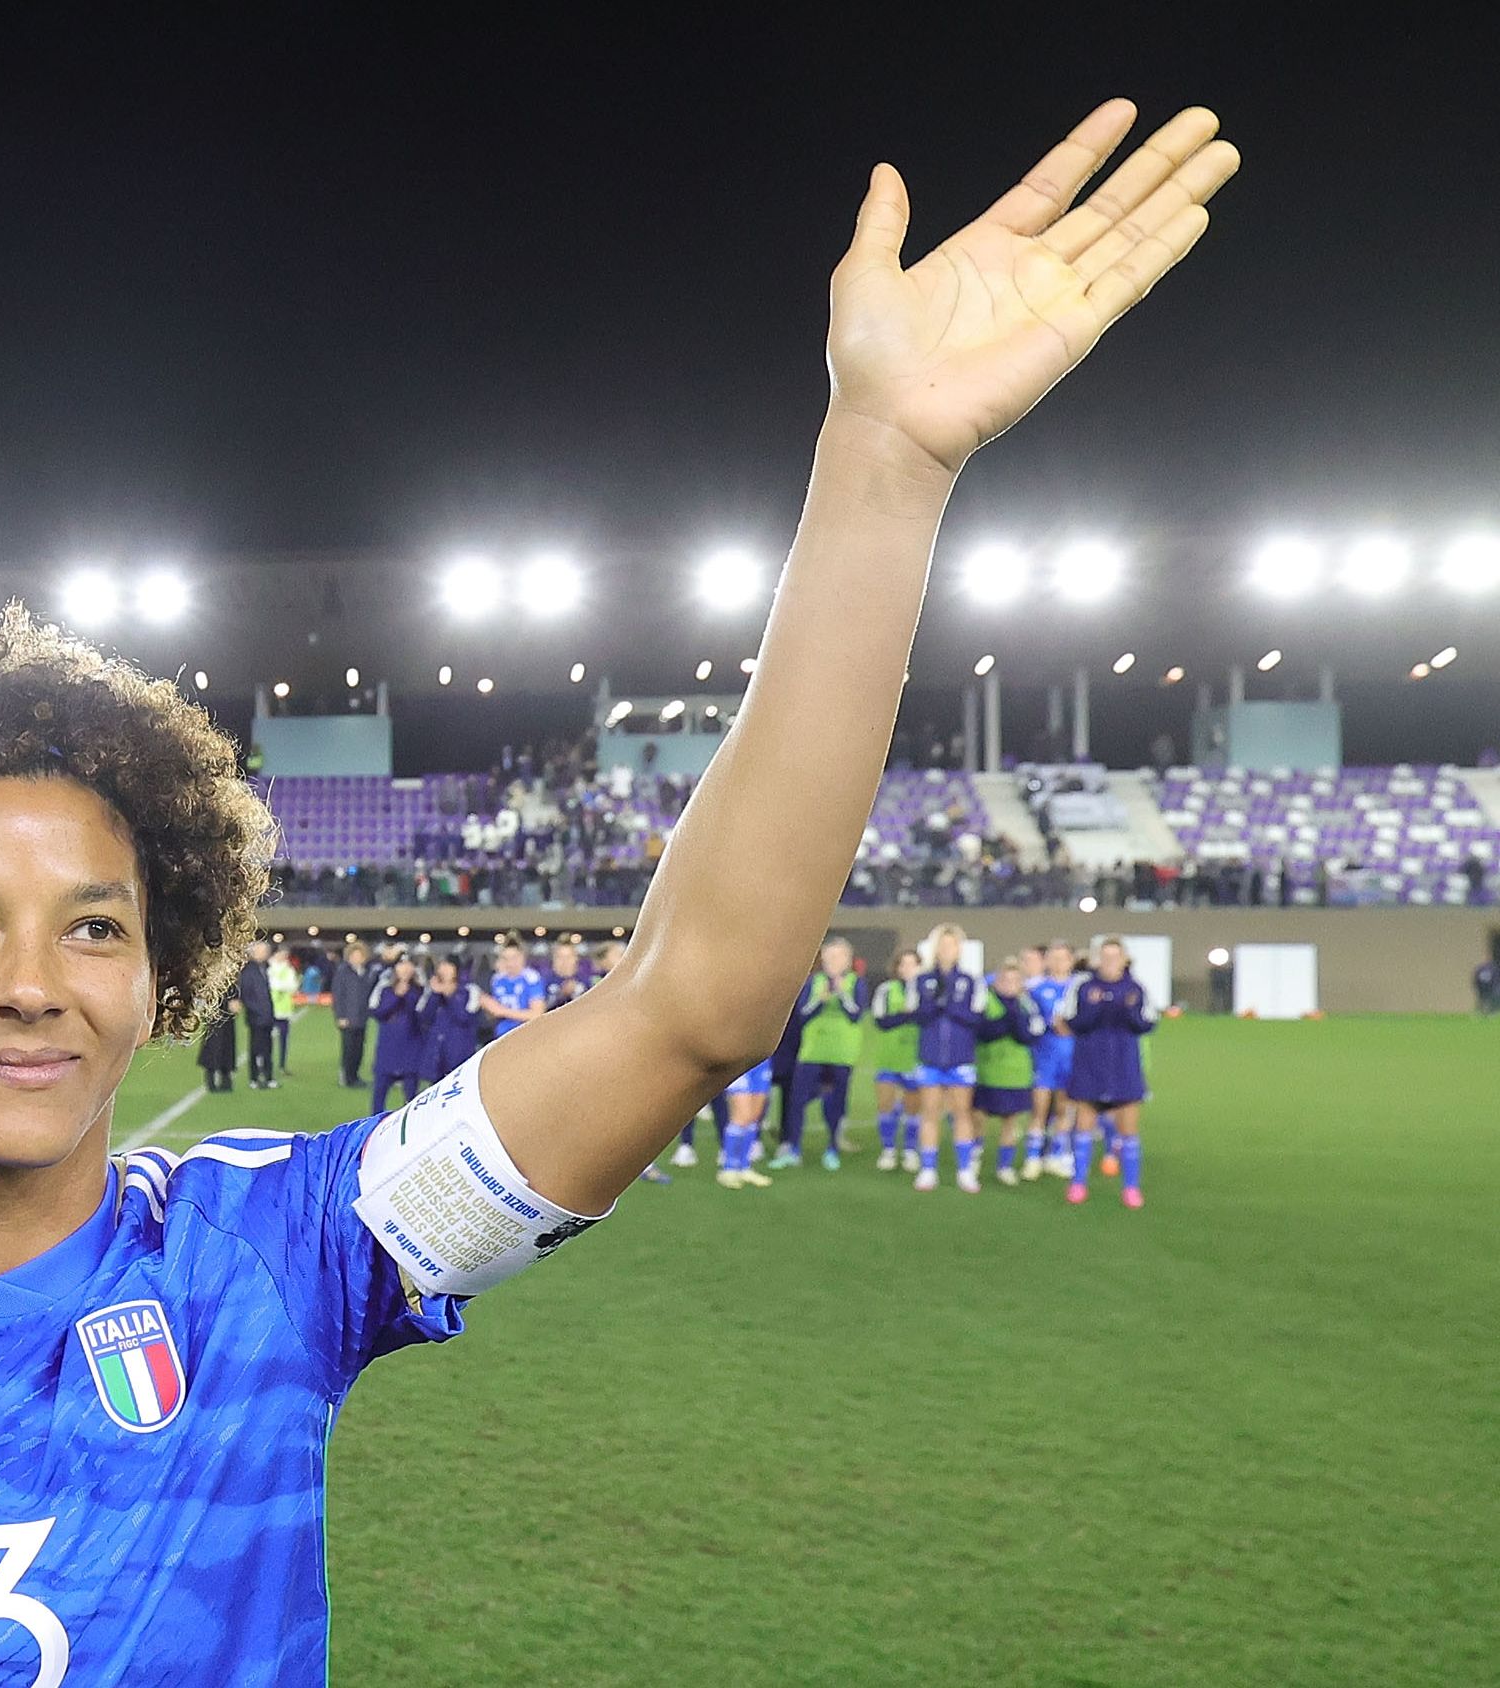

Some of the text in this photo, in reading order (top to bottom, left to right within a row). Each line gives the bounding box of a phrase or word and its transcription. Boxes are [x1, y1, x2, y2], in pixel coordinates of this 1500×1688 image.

[439, 1155, 527, 1235] AZZURRO VALORI
[460, 1146, 506, 1196] CAPITANO
[399, 1180, 493, 1265] GRUPPO RISPETTO
[410, 1169, 507, 1257] INSIEME PASSIONE
[419, 1155, 524, 1249] ISPIRAZIONE AMORE
[500, 1192, 541, 1219] GRAZIE
[389, 1191, 478, 1273] EMOZIONI STORIA
[396, 1233, 422, 1259] volte
[419, 1257, 444, 1277] 140
[85, 1309, 161, 1348] ITALIA
[117, 1338, 140, 1351] FIGC
